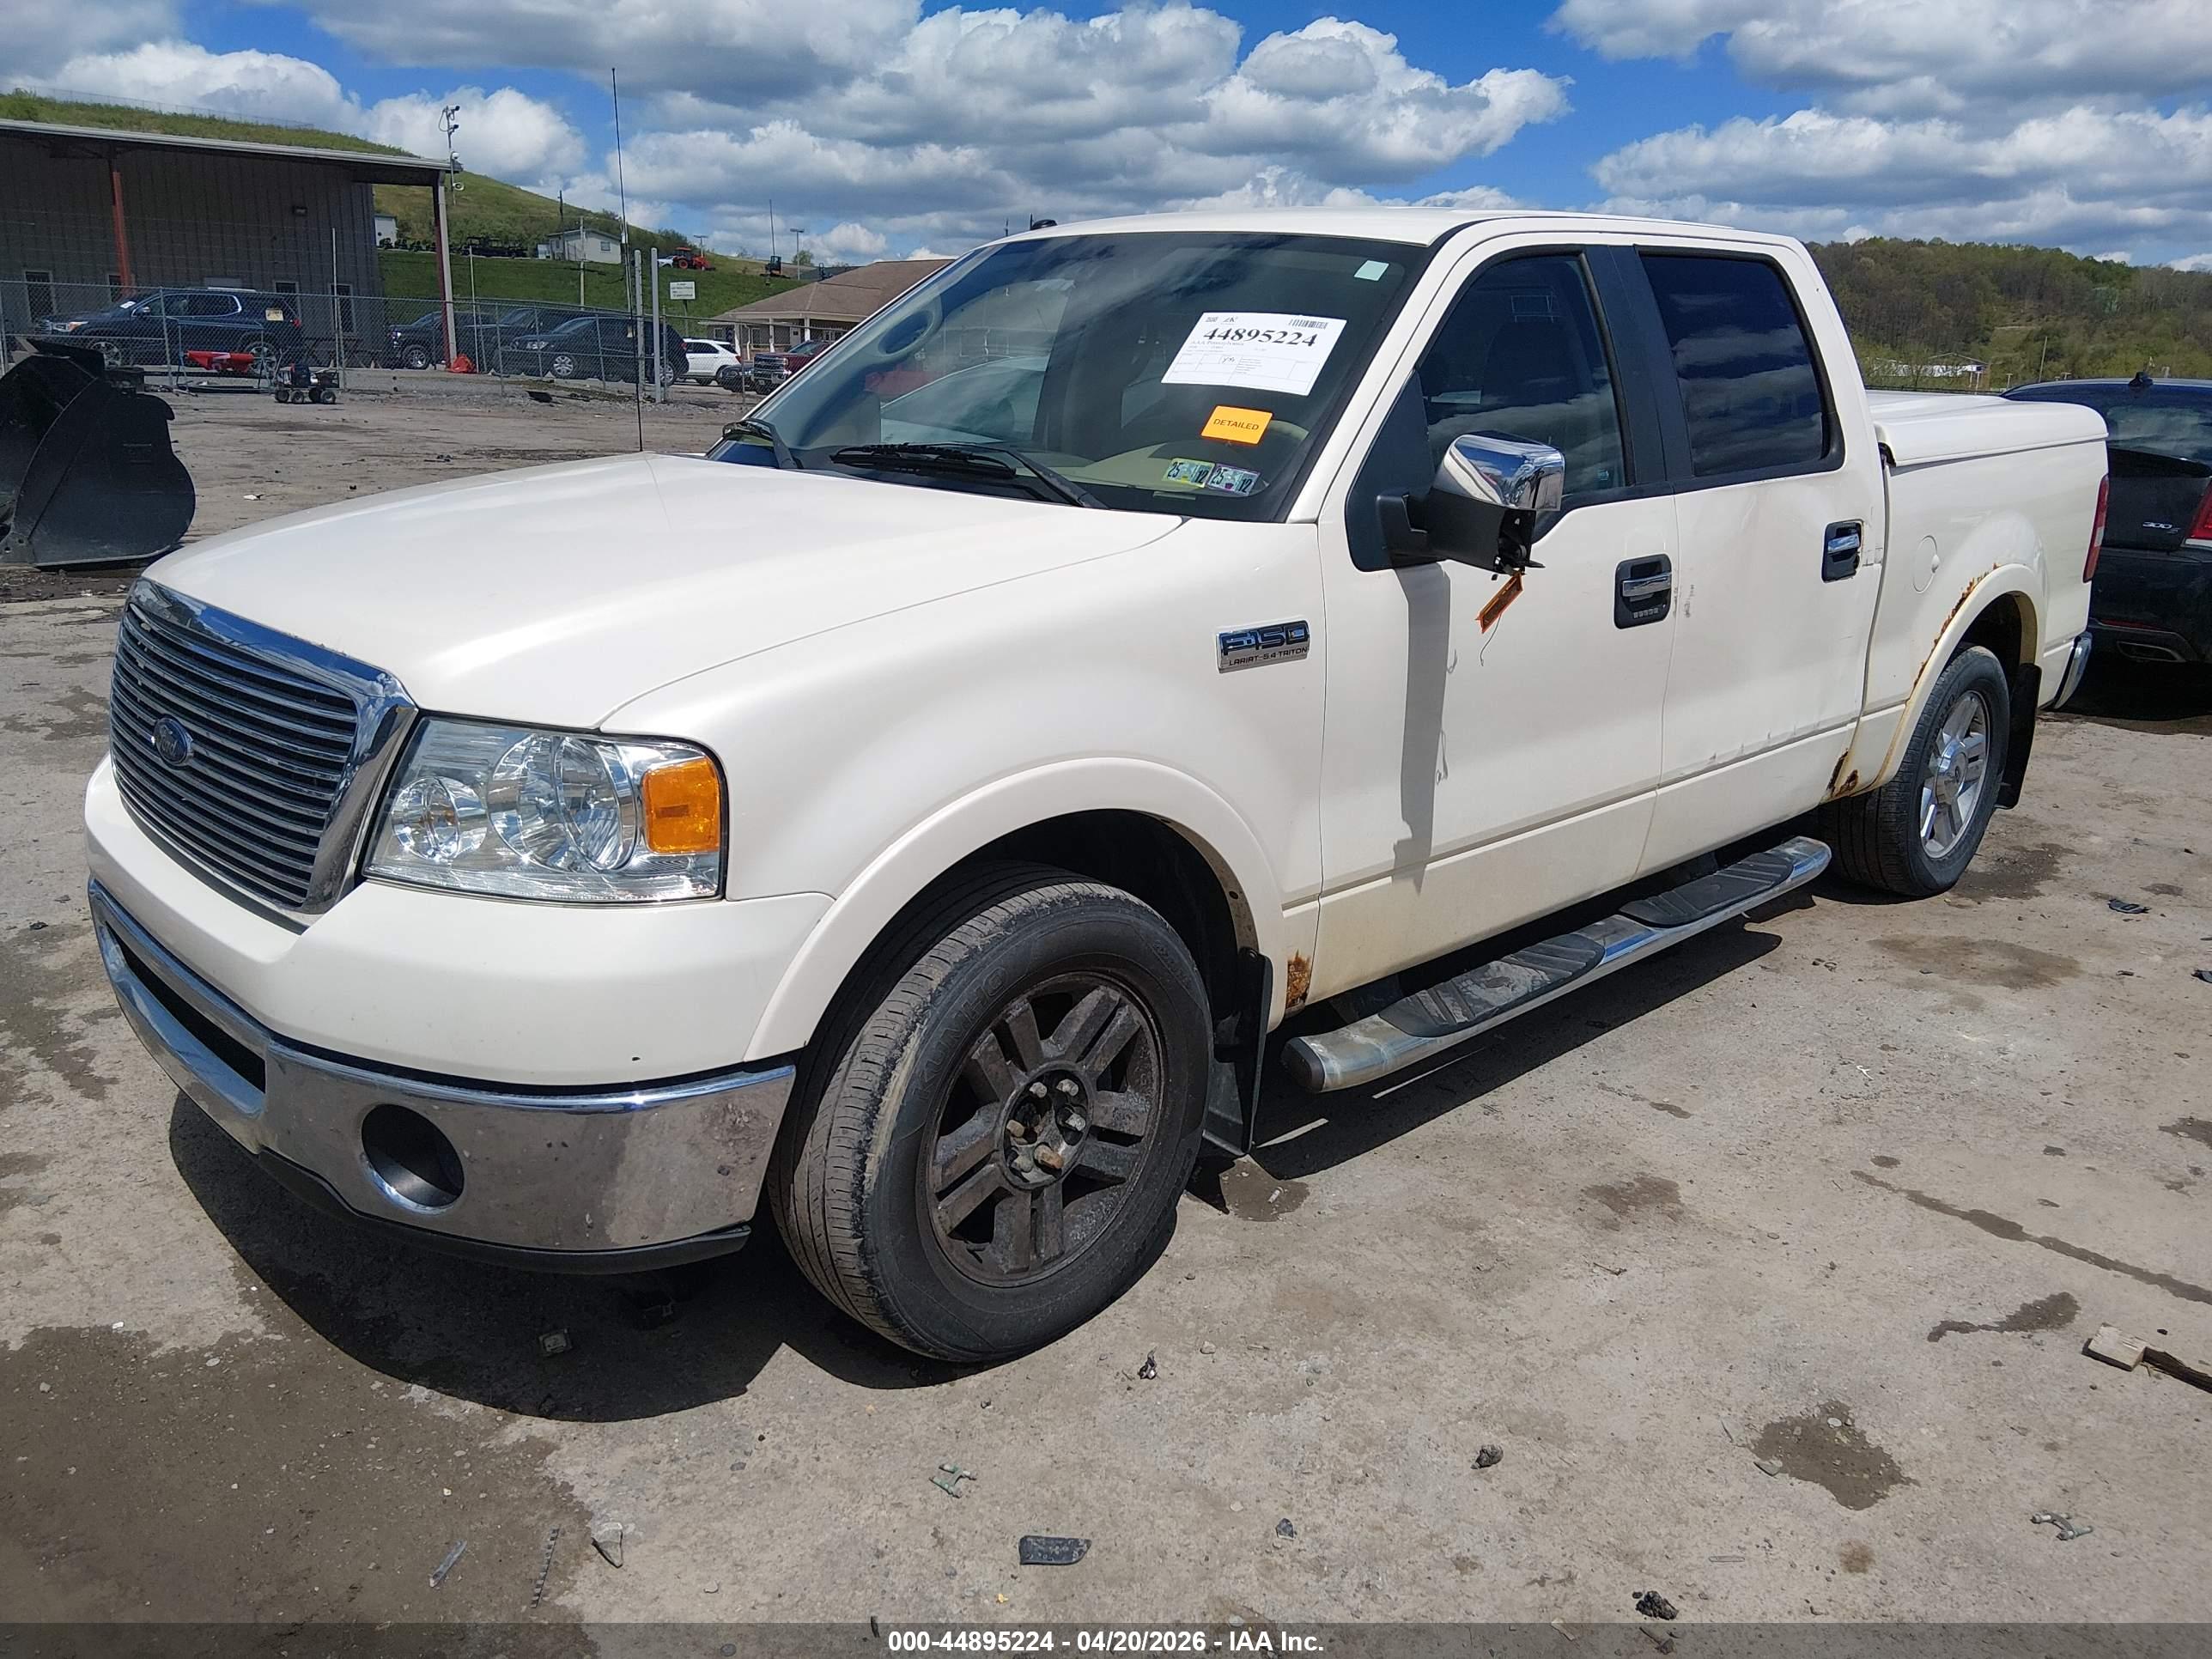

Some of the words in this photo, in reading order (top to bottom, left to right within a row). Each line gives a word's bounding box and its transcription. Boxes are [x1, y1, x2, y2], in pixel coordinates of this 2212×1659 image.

[1204, 328, 1318, 347] 44895224
[1212, 418, 1260, 431] DETAILED
[1167, 461, 1183, 478] 25
[1194, 469, 1209, 483] 12
[1211, 467, 1228, 485] 25
[1237, 477, 1253, 493] 12
[1229, 655, 1259, 666] LARIAT
[1279, 646, 1308, 658] TRITON
[912, 965, 1008, 1102] KUMHO
